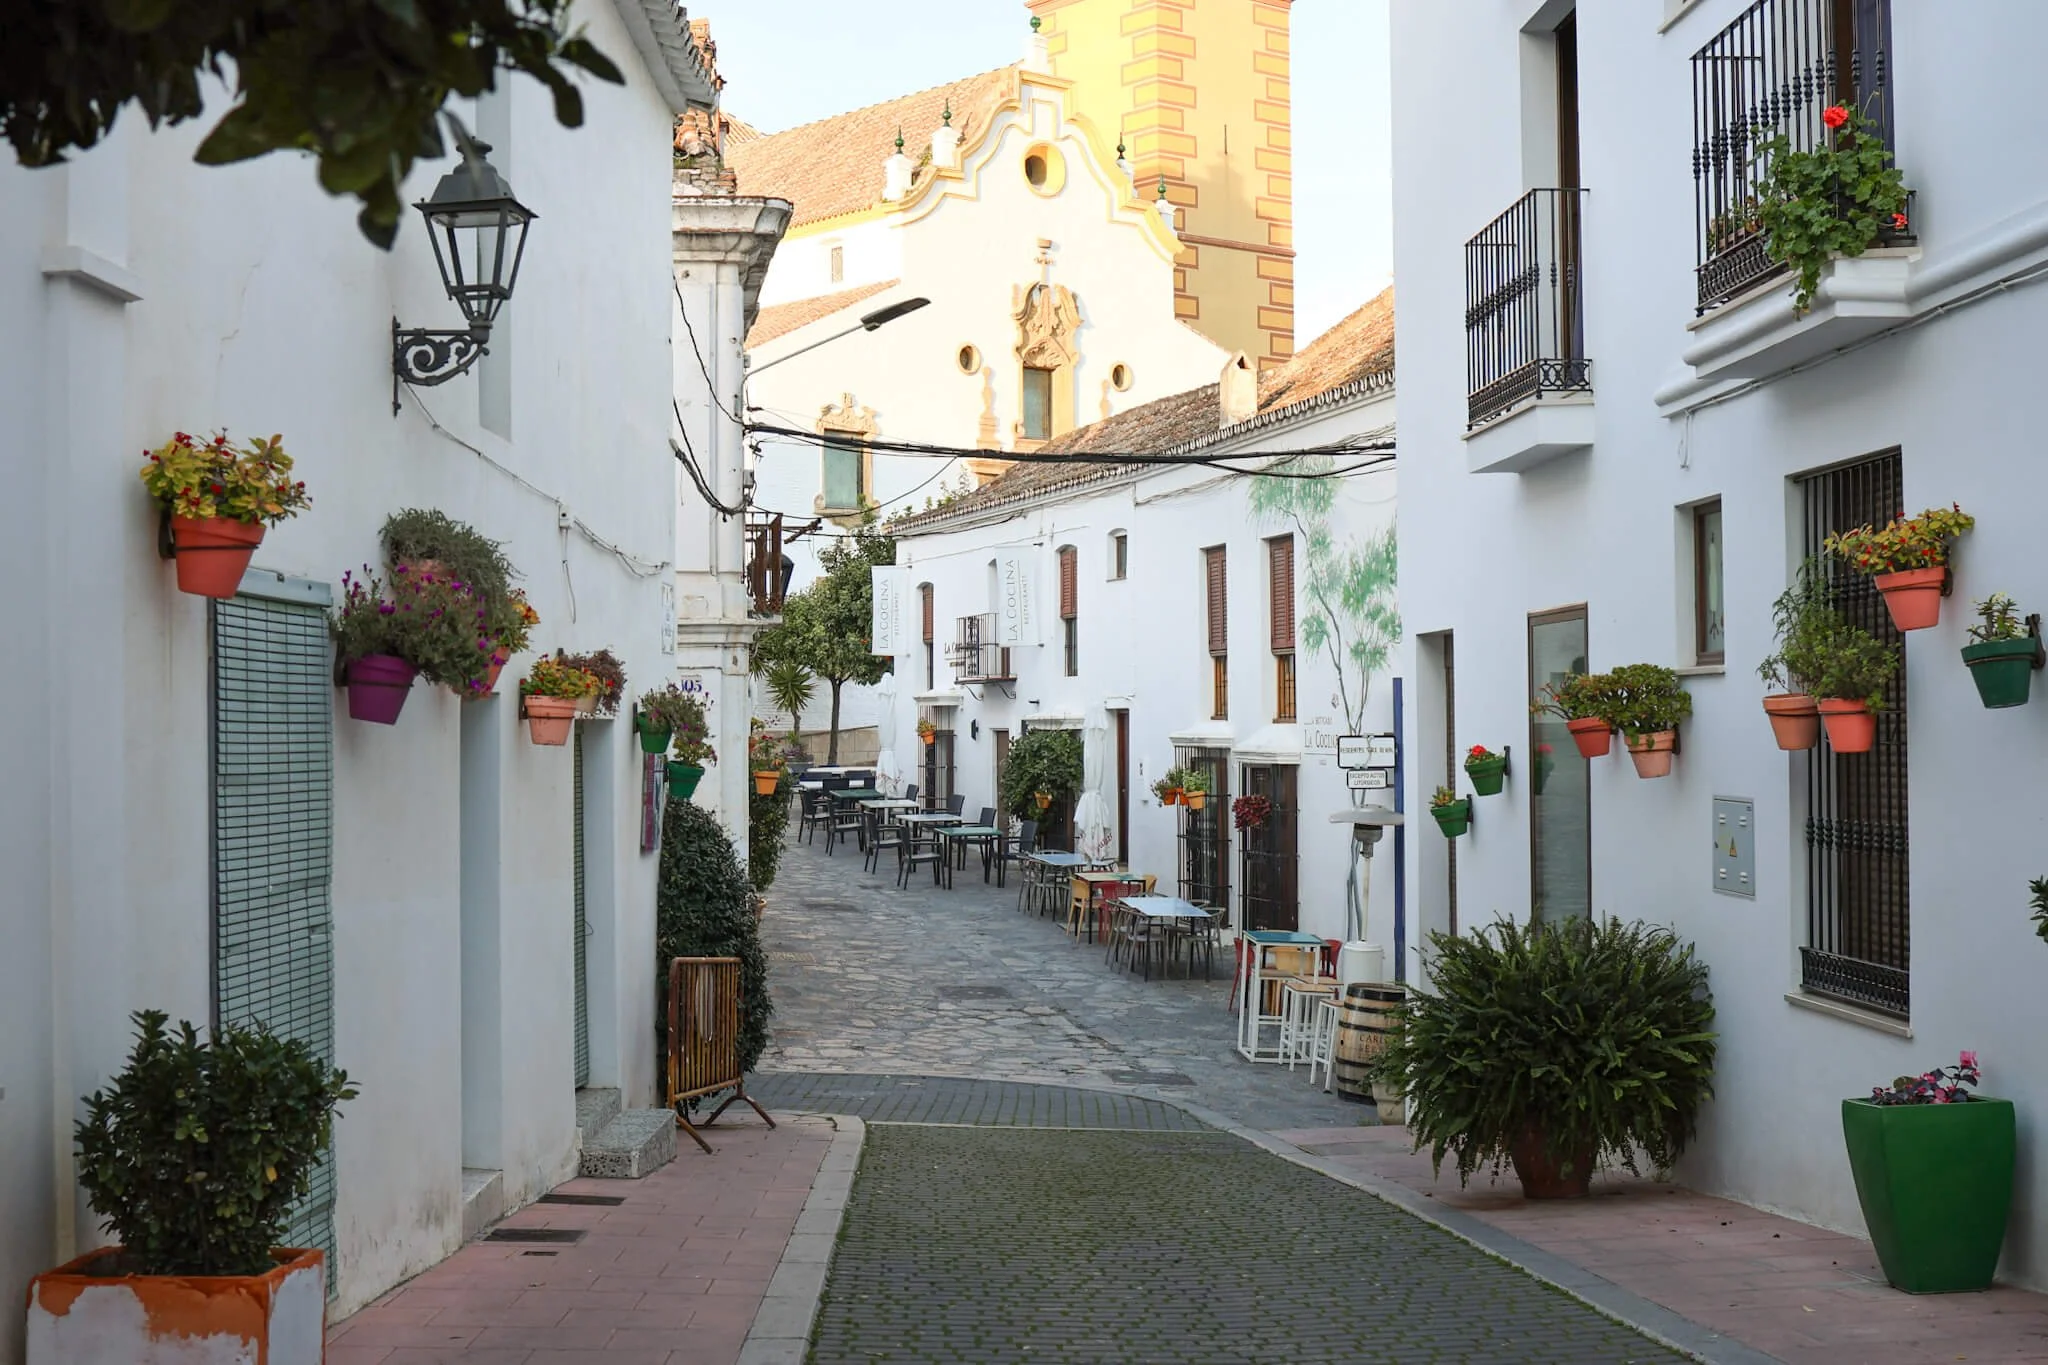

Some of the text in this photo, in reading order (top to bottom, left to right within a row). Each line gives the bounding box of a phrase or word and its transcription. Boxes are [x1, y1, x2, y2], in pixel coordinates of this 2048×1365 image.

[880, 579, 889, 649] LA COCINA
[1006, 560, 1017, 641] LA COCINA
